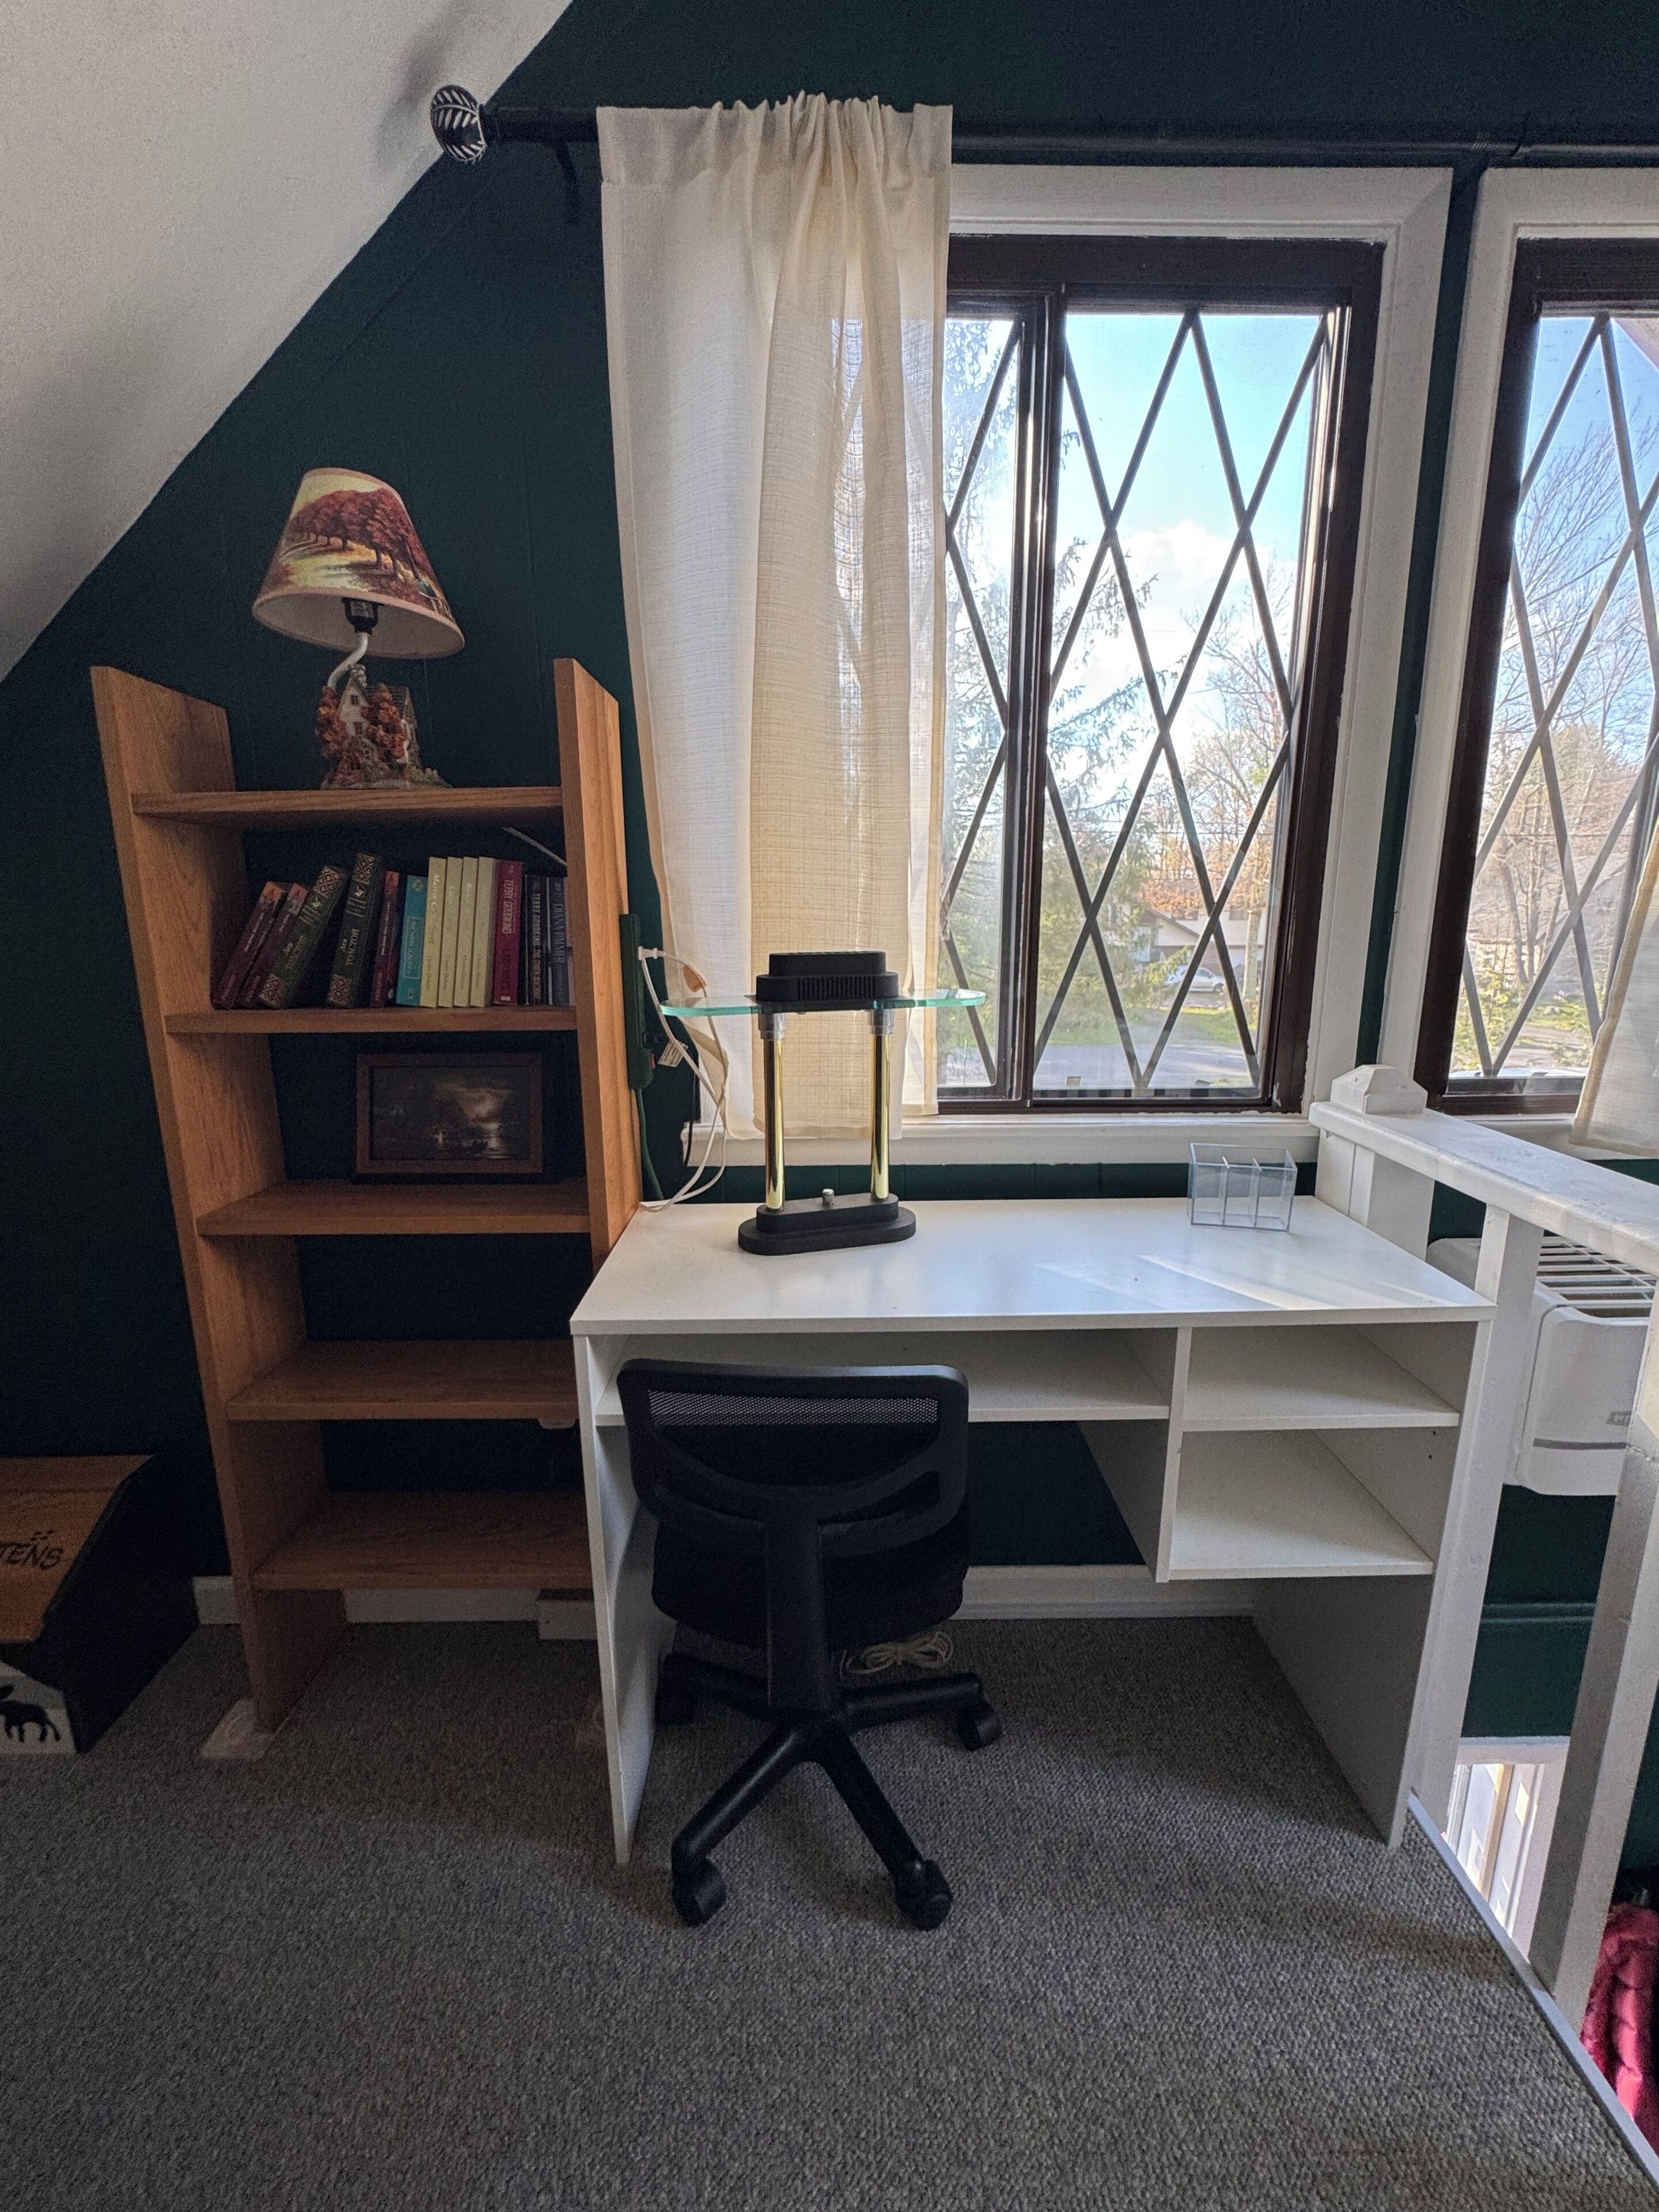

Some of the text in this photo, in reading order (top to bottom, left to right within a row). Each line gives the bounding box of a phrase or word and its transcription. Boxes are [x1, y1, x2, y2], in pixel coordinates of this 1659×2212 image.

[501, 879, 514, 934] TERRY GOODKIND
[552, 903, 564, 930] DIANA
[553, 931, 566, 963] PALMER
